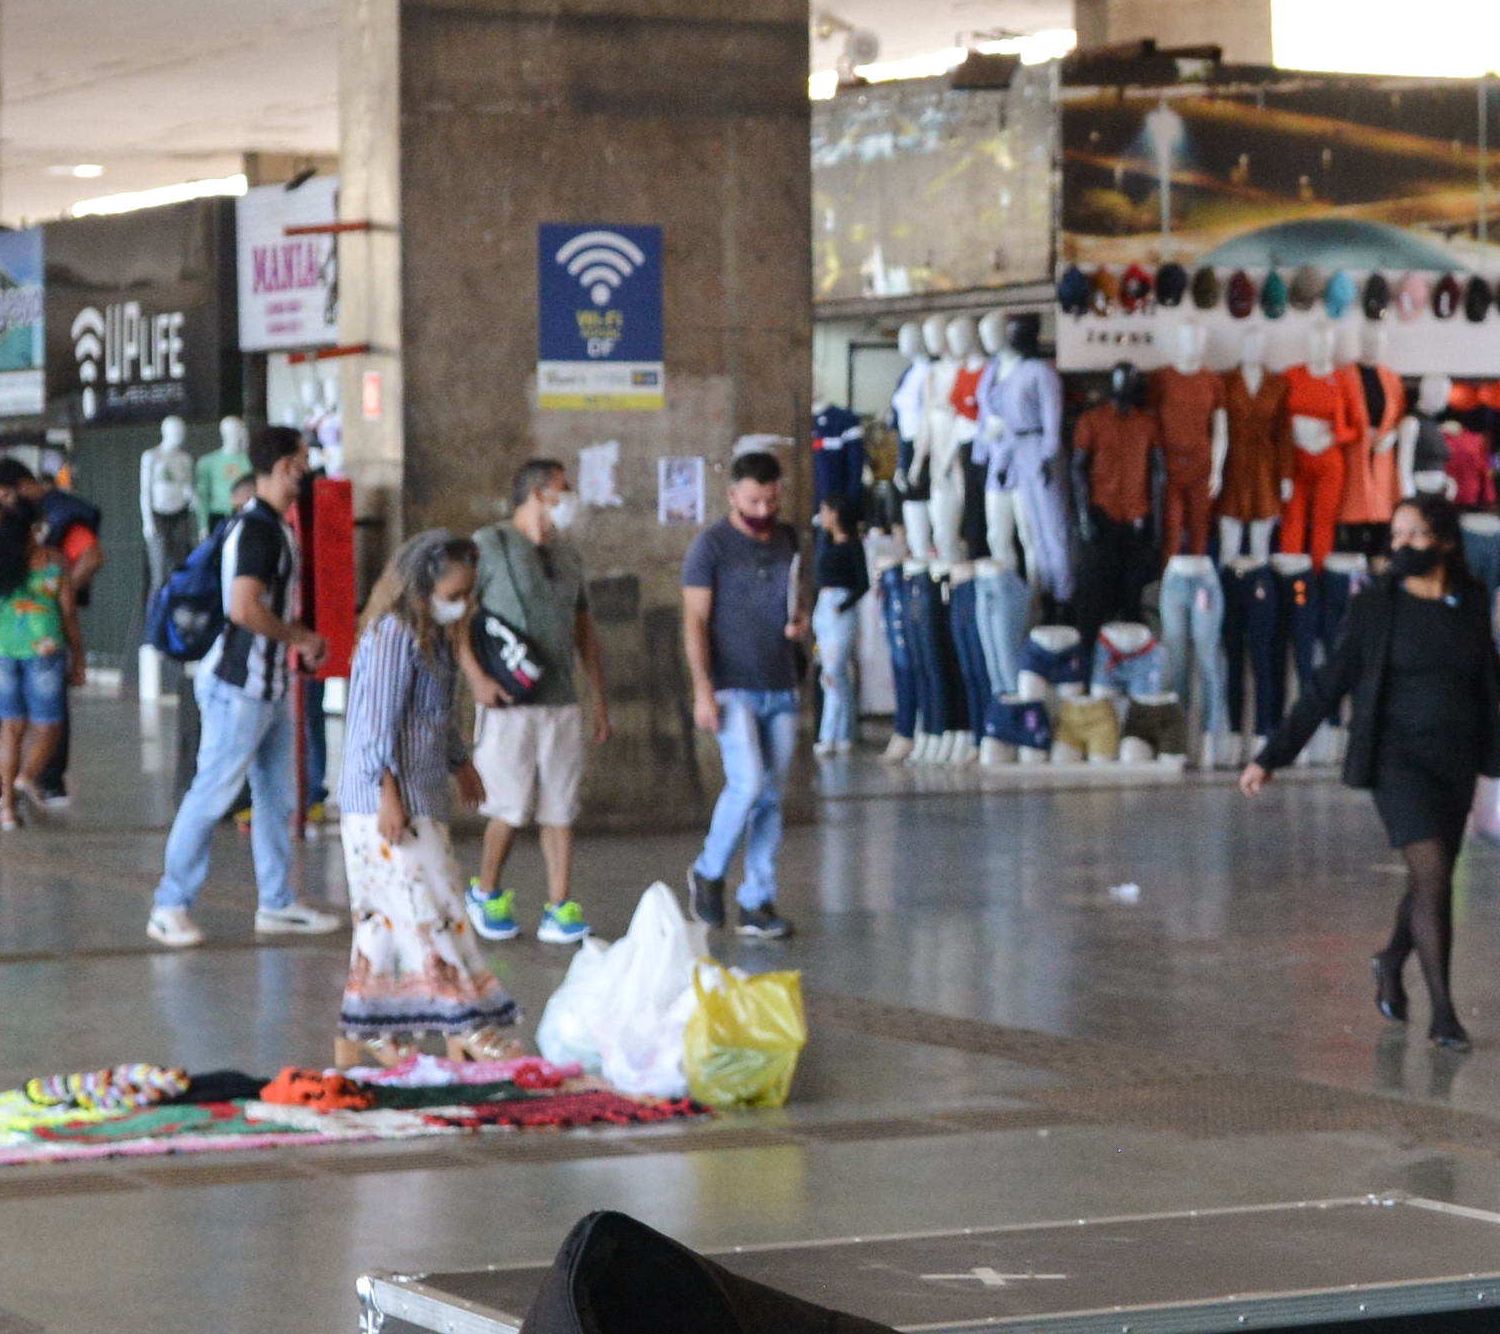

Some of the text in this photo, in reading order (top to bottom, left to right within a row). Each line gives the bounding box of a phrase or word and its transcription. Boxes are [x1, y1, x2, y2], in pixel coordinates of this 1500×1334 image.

[252, 241, 319, 296] MANIA
[106, 300, 185, 384] UPLIFE
[587, 337, 615, 358] DF
